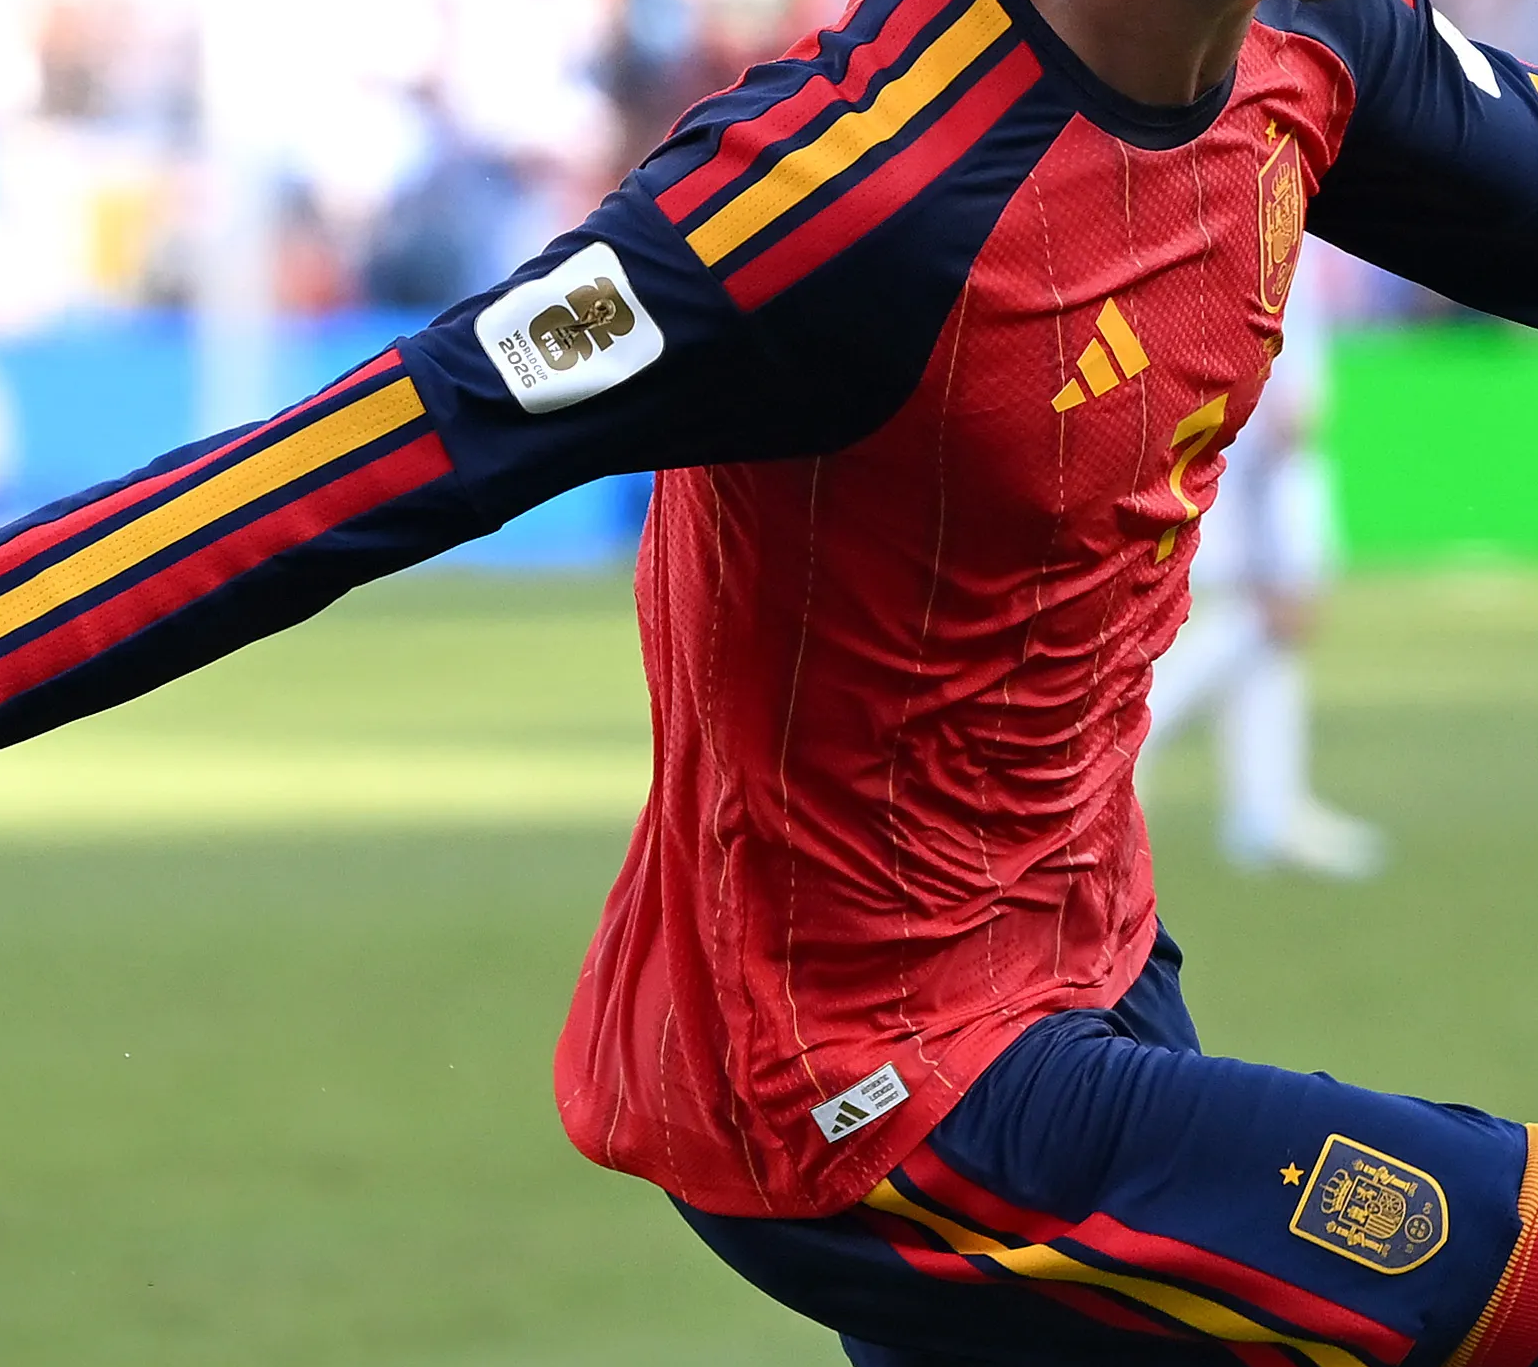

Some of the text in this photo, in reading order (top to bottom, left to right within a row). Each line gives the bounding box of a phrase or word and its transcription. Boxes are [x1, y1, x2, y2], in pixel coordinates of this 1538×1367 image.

[498, 337, 537, 389] 2026
[514, 330, 548, 380] WORLD CUP
[541, 331, 564, 361] FIFA
